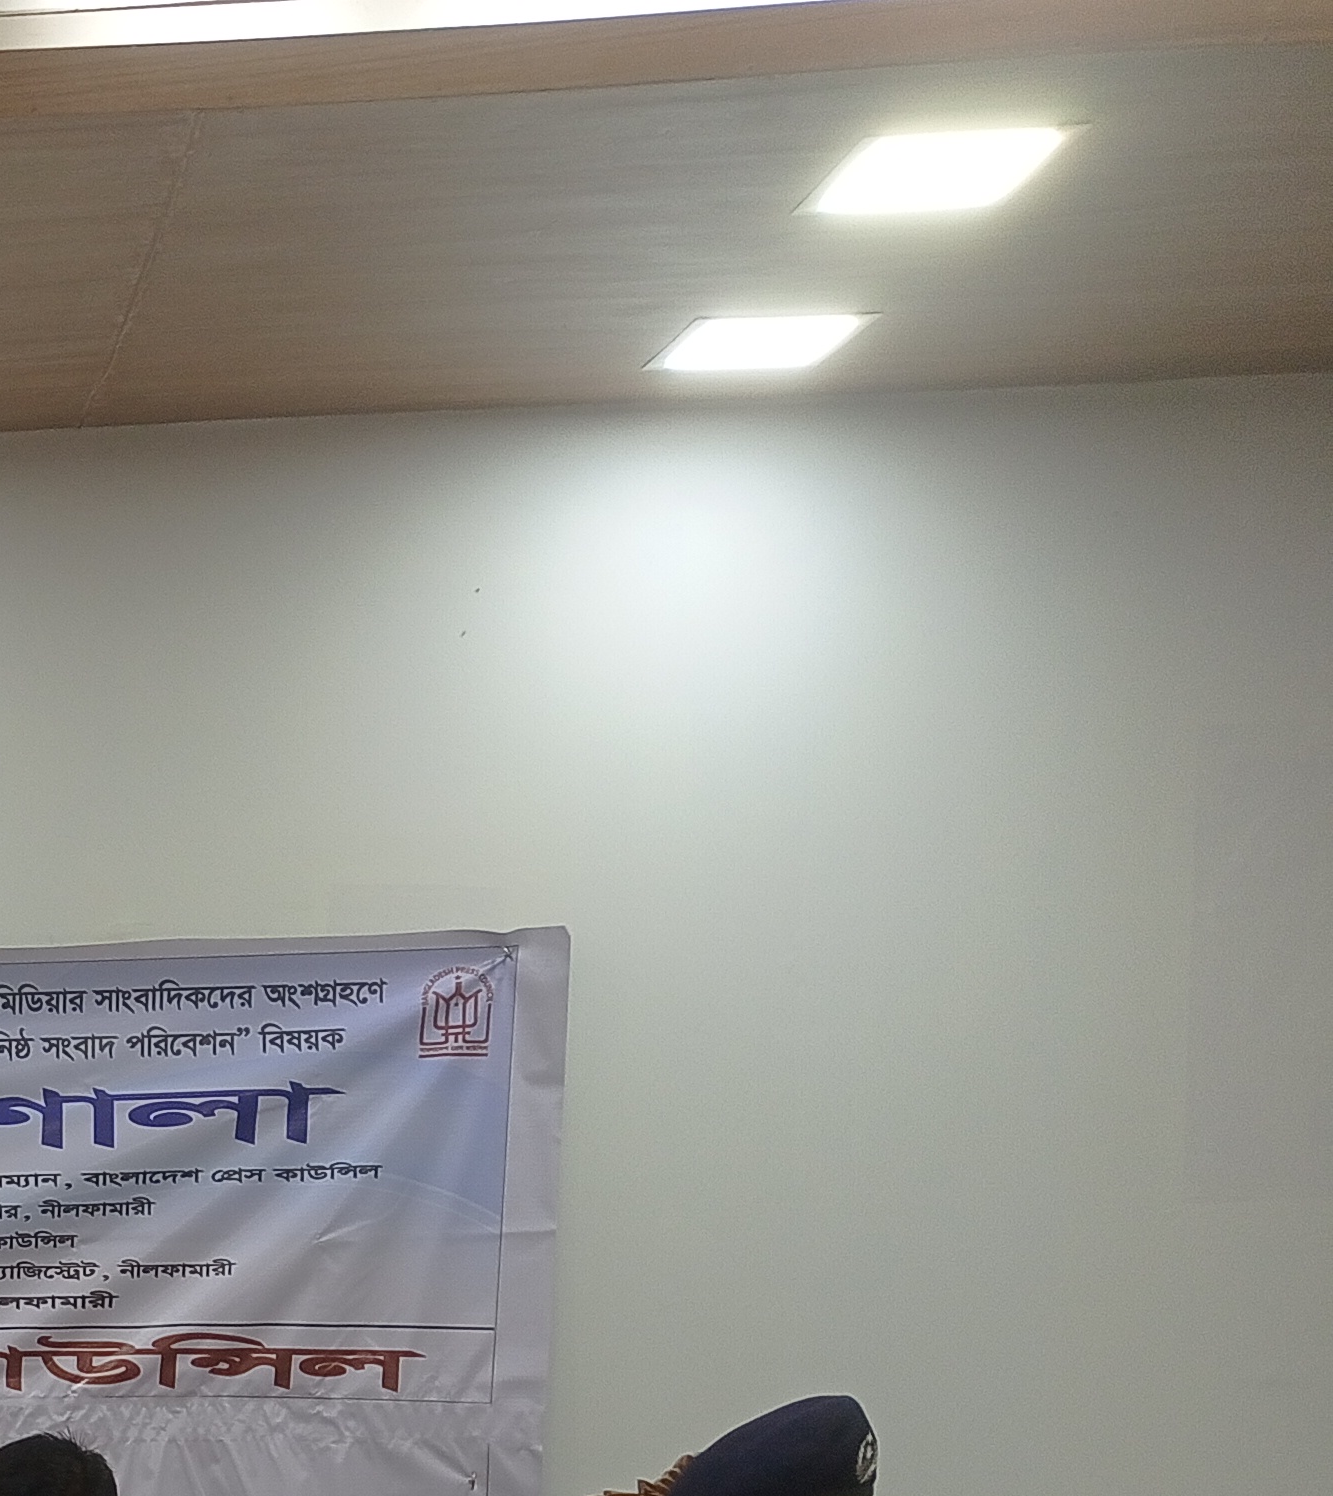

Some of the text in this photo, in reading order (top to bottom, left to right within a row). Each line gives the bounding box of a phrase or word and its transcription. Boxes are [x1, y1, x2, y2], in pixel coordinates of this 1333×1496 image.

[91, 979, 257, 1015] সাংবাদিকদের
[261, 977, 389, 1010] অংশগ্রহণে
[39, 1033, 120, 1062] সংবাদ
[257, 1022, 347, 1054] বিষয়ক
[79, 1167, 205, 1188] বাংলাদেশ
[210, 1167, 267, 1184] প্রেস
[271, 1161, 384, 1183] কাউন্সিল
[37, 1196, 157, 1220] নীলফামারী
[116, 1258, 237, 1280] নীলফামারী
